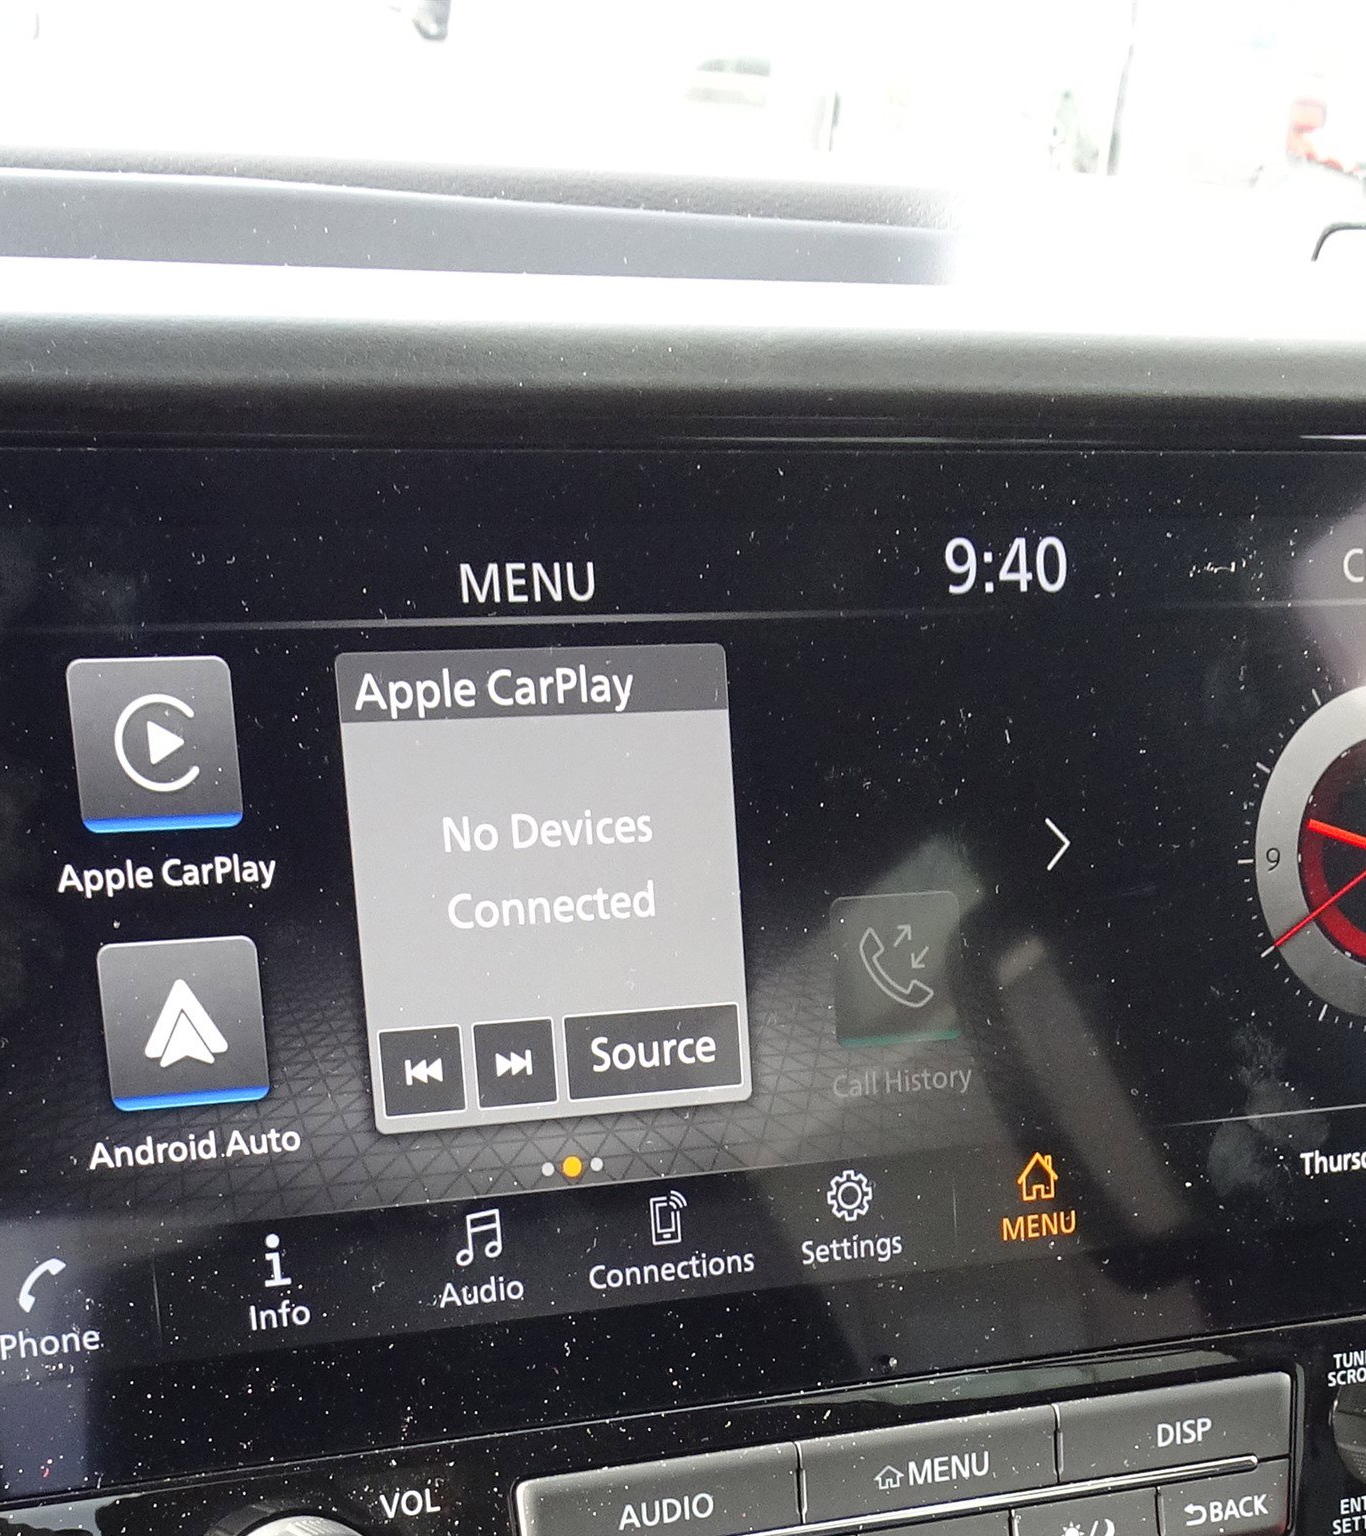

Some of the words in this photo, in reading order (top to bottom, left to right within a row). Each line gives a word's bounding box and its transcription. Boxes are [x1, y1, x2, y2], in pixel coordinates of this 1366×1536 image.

[459, 560, 598, 604] MENU
[943, 536, 1068, 595] 9:40
[354, 671, 477, 719] Apple
[488, 664, 635, 713] CarPlay
[440, 814, 499, 854] No
[510, 810, 654, 850] Devices
[58, 860, 154, 899] Apple
[161, 855, 277, 891] CarPlay
[1266, 848, 1281, 872] 9
[447, 882, 657, 930] Connected
[590, 1034, 717, 1075] Source
[832, 1070, 881, 1100] Call
[886, 1063, 973, 1103] History
[89, 1132, 217, 1171] Android
[226, 1126, 302, 1160] Auto
[1001, 1209, 1076, 1242] MENU
[801, 1232, 903, 1268] Settings
[589, 1248, 756, 1291] Connections
[439, 1273, 525, 1308] Audio
[249, 1299, 311, 1332] Info
[0, 1325, 100, 1361] Phone
[1156, 1417, 1212, 1449] DISP
[907, 1452, 992, 1486] MENU
[380, 1487, 442, 1520] VOL
[618, 1493, 716, 1531] AUDIO
[1208, 1494, 1269, 1525] BACK
